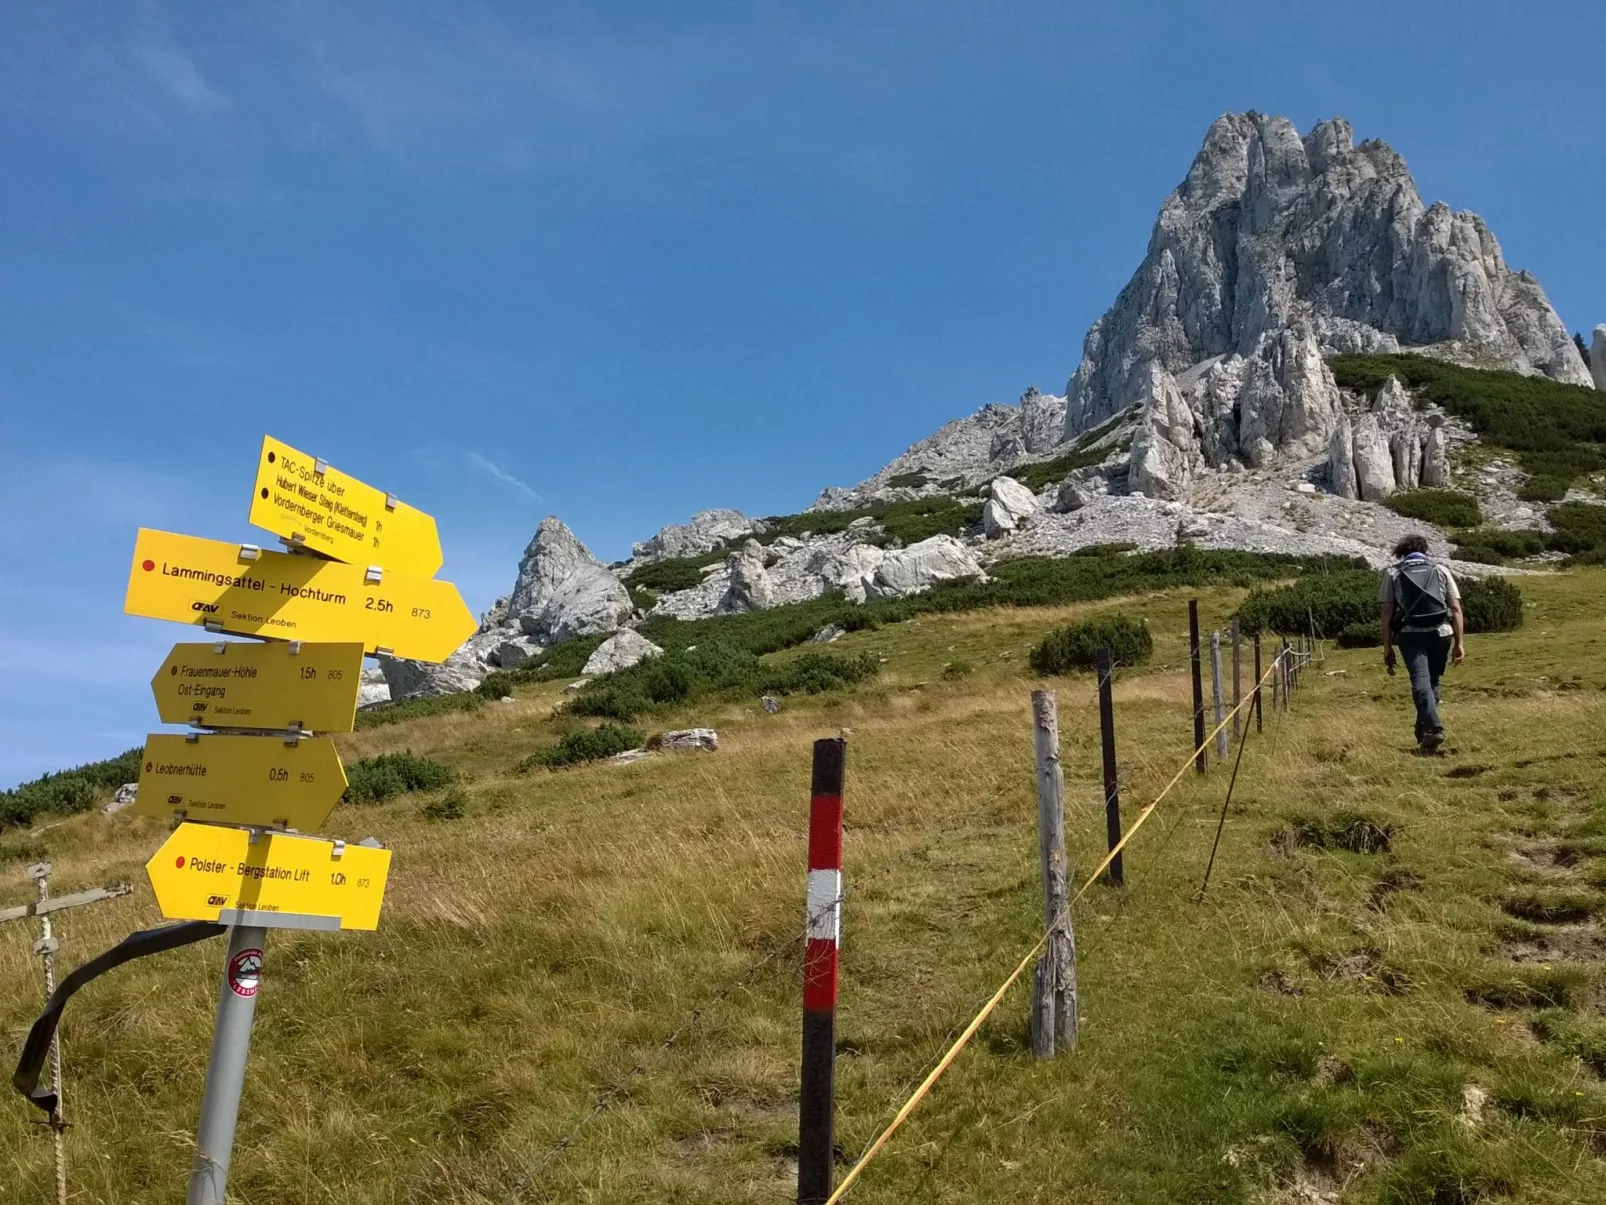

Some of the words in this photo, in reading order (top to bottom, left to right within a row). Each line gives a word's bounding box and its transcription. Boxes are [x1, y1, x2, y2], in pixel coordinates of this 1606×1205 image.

[281, 457, 325, 488] TAC-Spitze
[327, 478, 345, 497] über
[276, 475, 297, 494] Hubert
[298, 486, 318, 502] Wieser
[319, 494, 333, 512] Steig
[274, 492, 324, 524] Vordernberger
[327, 516, 365, 542] Griesmauer
[304, 524, 334, 545] Vordernberg
[162, 562, 265, 592] Lammingsattel
[280, 583, 346, 605] Hochturm
[365, 597, 393, 613] 2.5h
[411, 608, 431, 620] 873
[231, 610, 263, 623] Sektion
[265, 616, 297, 628] Leoben
[180, 665, 258, 679] Frauenmauer-Höhle
[328, 670, 342, 680] 805
[178, 683, 225, 698] Ost-Eingang
[214, 705, 233, 715] Sektion
[233, 707, 252, 715] Leoben
[155, 762, 207, 777] Leobnerhütte
[300, 773, 315, 783] 805
[188, 799, 207, 809] Sektion
[207, 801, 226, 810] Leoben
[189, 858, 227, 874] Polster
[237, 863, 292, 881] Bergstation
[294, 868, 310, 882] Lift
[356, 878, 370, 889] 873
[235, 900, 256, 910] Sektion
[258, 903, 280, 912] Leoben
